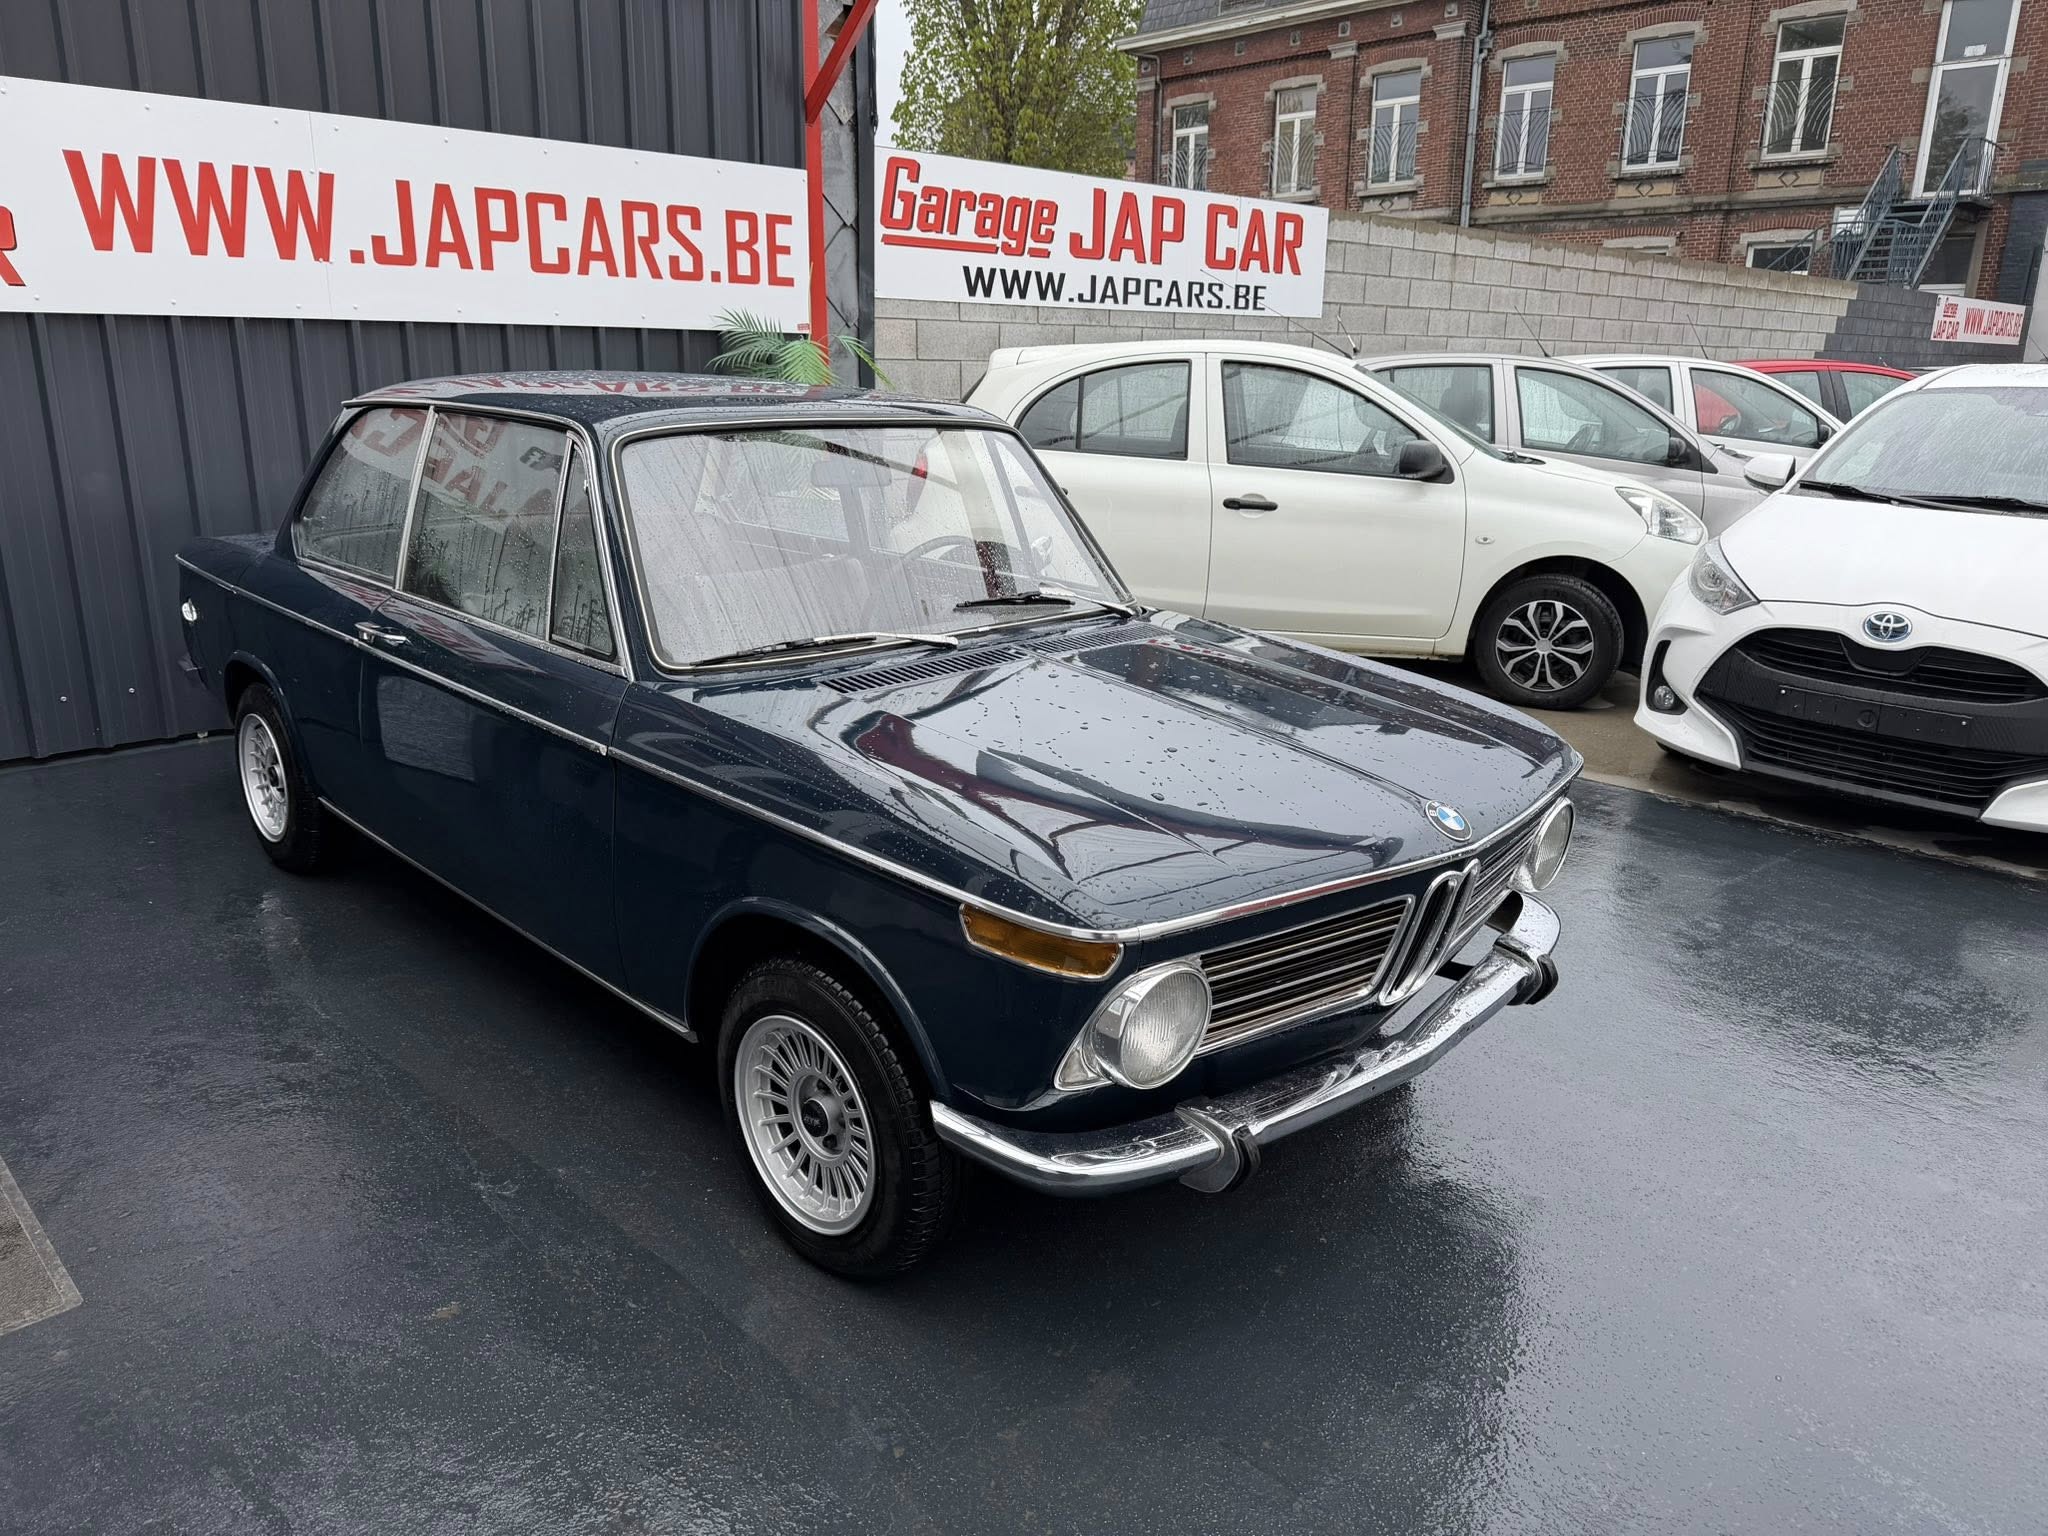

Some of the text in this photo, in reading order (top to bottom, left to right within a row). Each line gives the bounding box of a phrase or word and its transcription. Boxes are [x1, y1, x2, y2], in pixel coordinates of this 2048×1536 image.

[63, 150, 796, 288] WWW.JAPCARS.BE
[880, 157, 1305, 276] Garage JAP CAR
[963, 265, 1267, 311] WWW.JAPCARS.BE
[1933, 319, 1960, 340] JAP CAR
[1963, 307, 2024, 338] WWW.JAPCARS.BE
